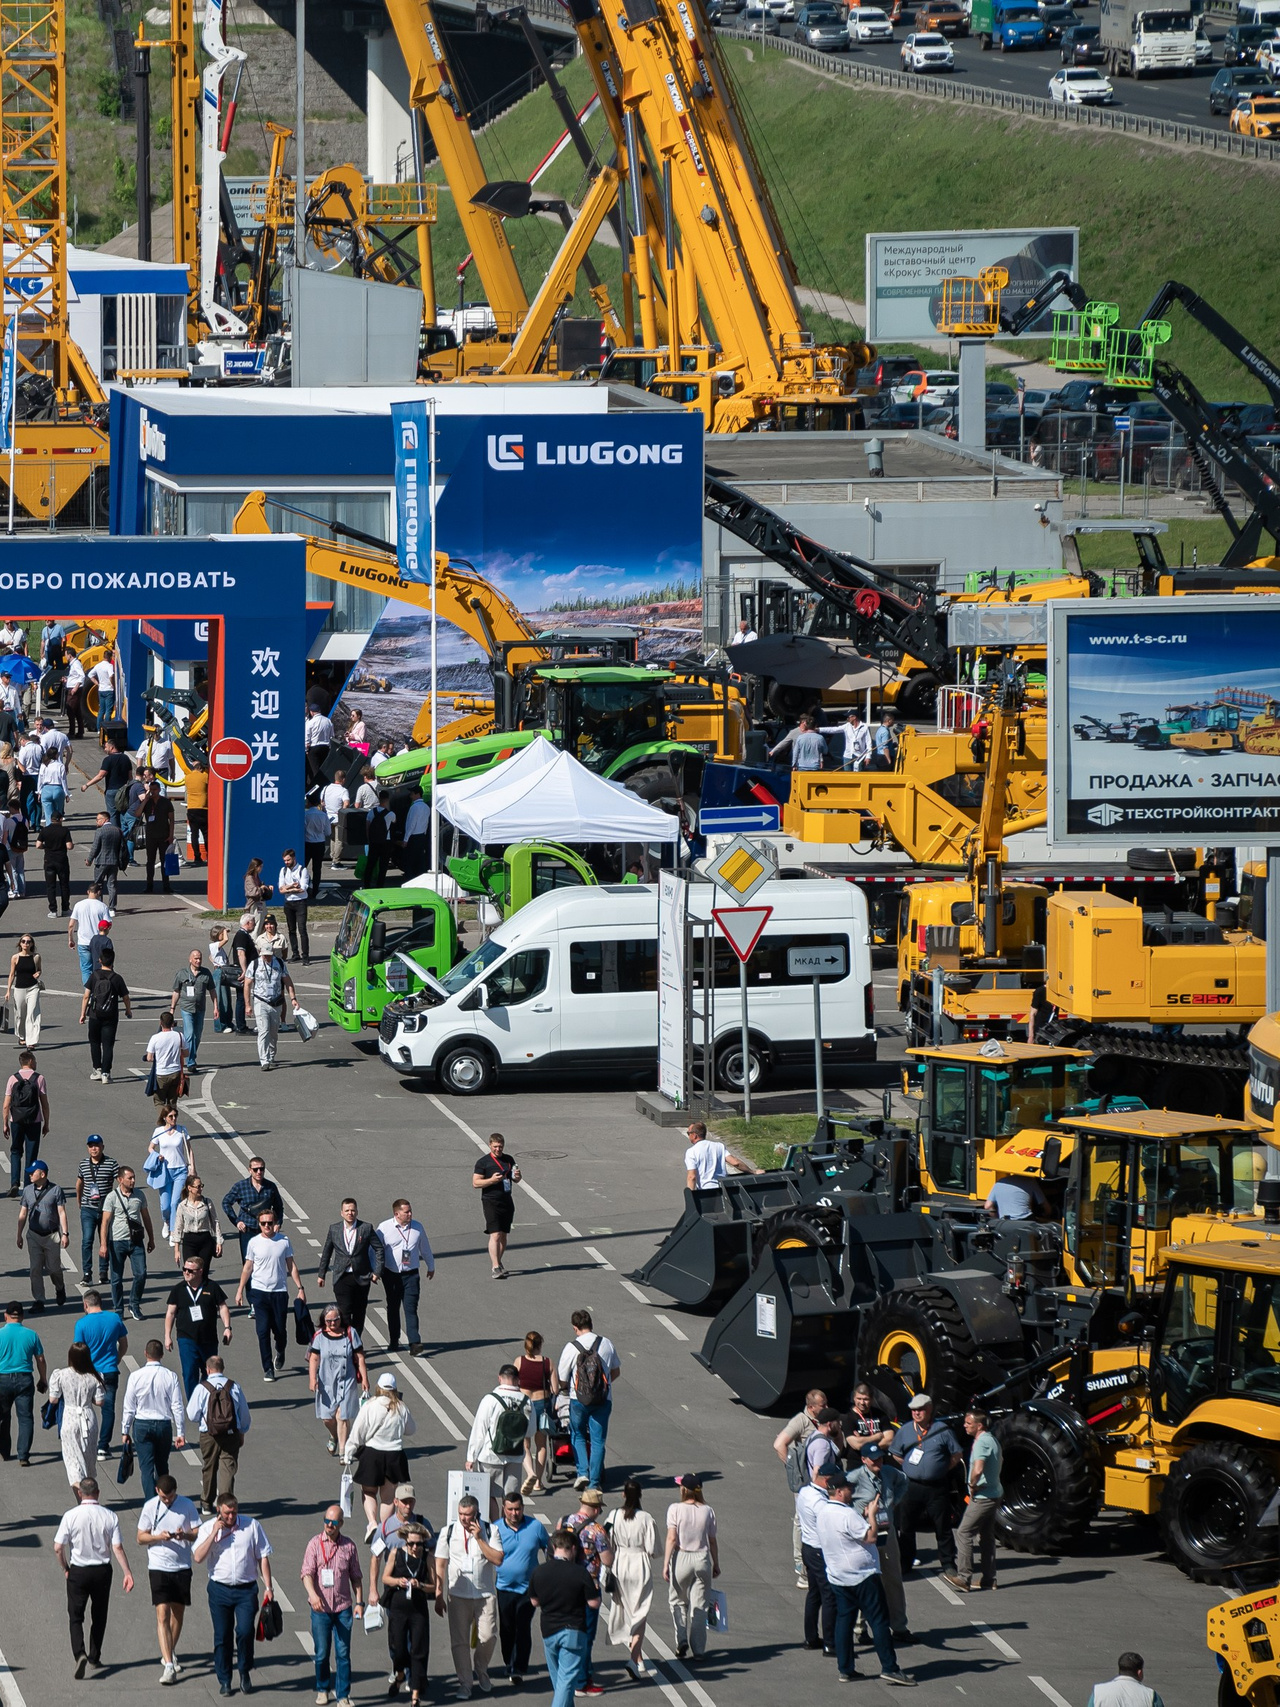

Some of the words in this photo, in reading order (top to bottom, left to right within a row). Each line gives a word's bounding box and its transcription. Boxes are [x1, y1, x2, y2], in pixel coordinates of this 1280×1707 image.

[680, 10, 696, 40] XCMG
[427, 31, 442, 60] XCMG
[668, 81, 684, 112] XCMG
[884, 245, 964, 256] Международный
[884, 257, 946, 266] выставочный
[948, 256, 976, 266] центр
[883, 268, 924, 278] «Крокус
[925, 267, 958, 277] Экспо»
[882, 287, 932, 296] СОВРЕМЕННАЯ
[71, 571, 237, 590] ПОЖАЛОВАТЬ
[1089, 633, 1188, 645] www.t-s-c.ru
[251, 646, 280, 804] 欢迎光临
[1089, 774, 1194, 791] ПРОДАЖА
[794, 957, 821, 966] МКАД
[1086, 1374, 1128, 1392] SHANTUI
